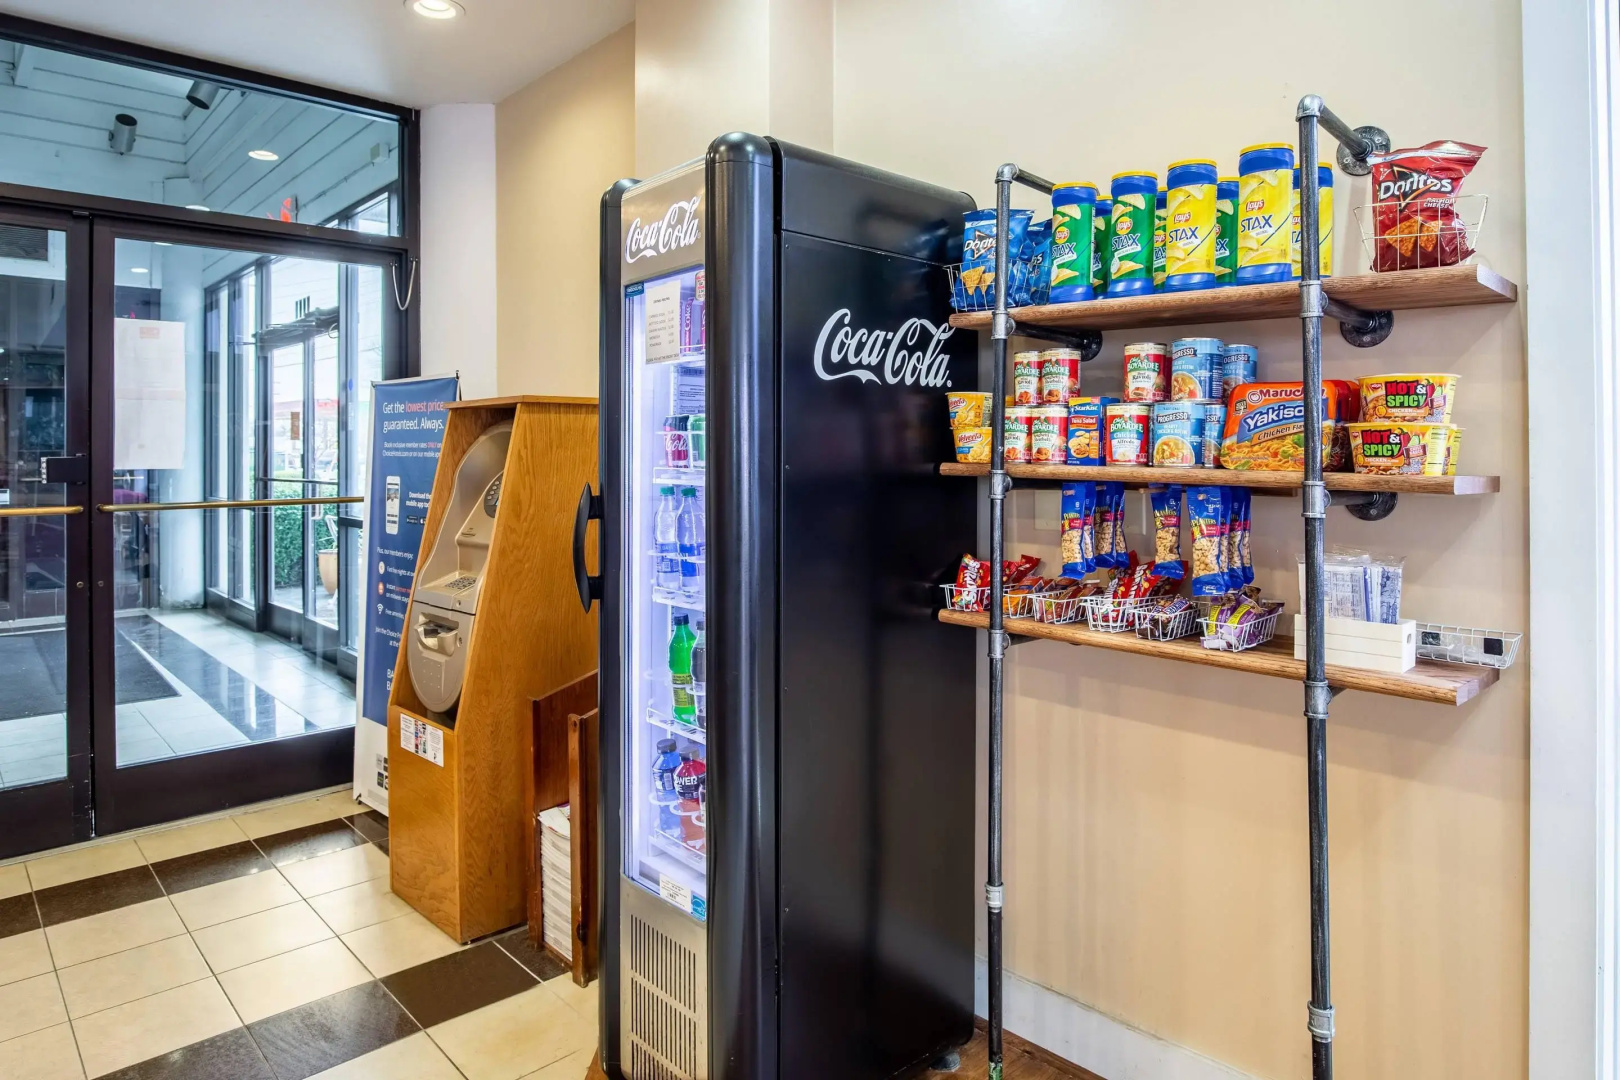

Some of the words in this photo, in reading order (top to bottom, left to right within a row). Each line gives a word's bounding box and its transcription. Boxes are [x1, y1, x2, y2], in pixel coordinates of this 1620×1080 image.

[1380, 173, 1452, 200] Doritos
[624, 195, 702, 264] Coca-Cola
[1240, 214, 1273, 233] STAX
[1112, 234, 1140, 251] STAX
[1168, 226, 1199, 244] STAX
[964, 236, 997, 252] Dorit
[1052, 242, 1076, 258] STAX
[814, 308, 956, 388] Coca-Cola
[1127, 360, 1160, 372] BOYARDEE
[1386, 382, 1418, 395] HOT
[1416, 384, 1427, 394] &
[383, 402, 394, 414] Get
[394, 401, 404, 414] the
[406, 400, 427, 412] lowest
[1386, 395, 1427, 407] SPICY
[383, 417, 419, 434] guaranteed.
[420, 416, 444, 432] Always.
[1157, 412, 1188, 424] PROGRESSO
[1245, 405, 1304, 431] Yakiso
[1110, 422, 1144, 432] BOYARDEE
[1258, 427, 1291, 441] Chicken
[958, 432, 982, 444] Velveeta
[1362, 431, 1390, 444] HOT
[1389, 434, 1400, 444] &
[1363, 444, 1400, 456] SPICY
